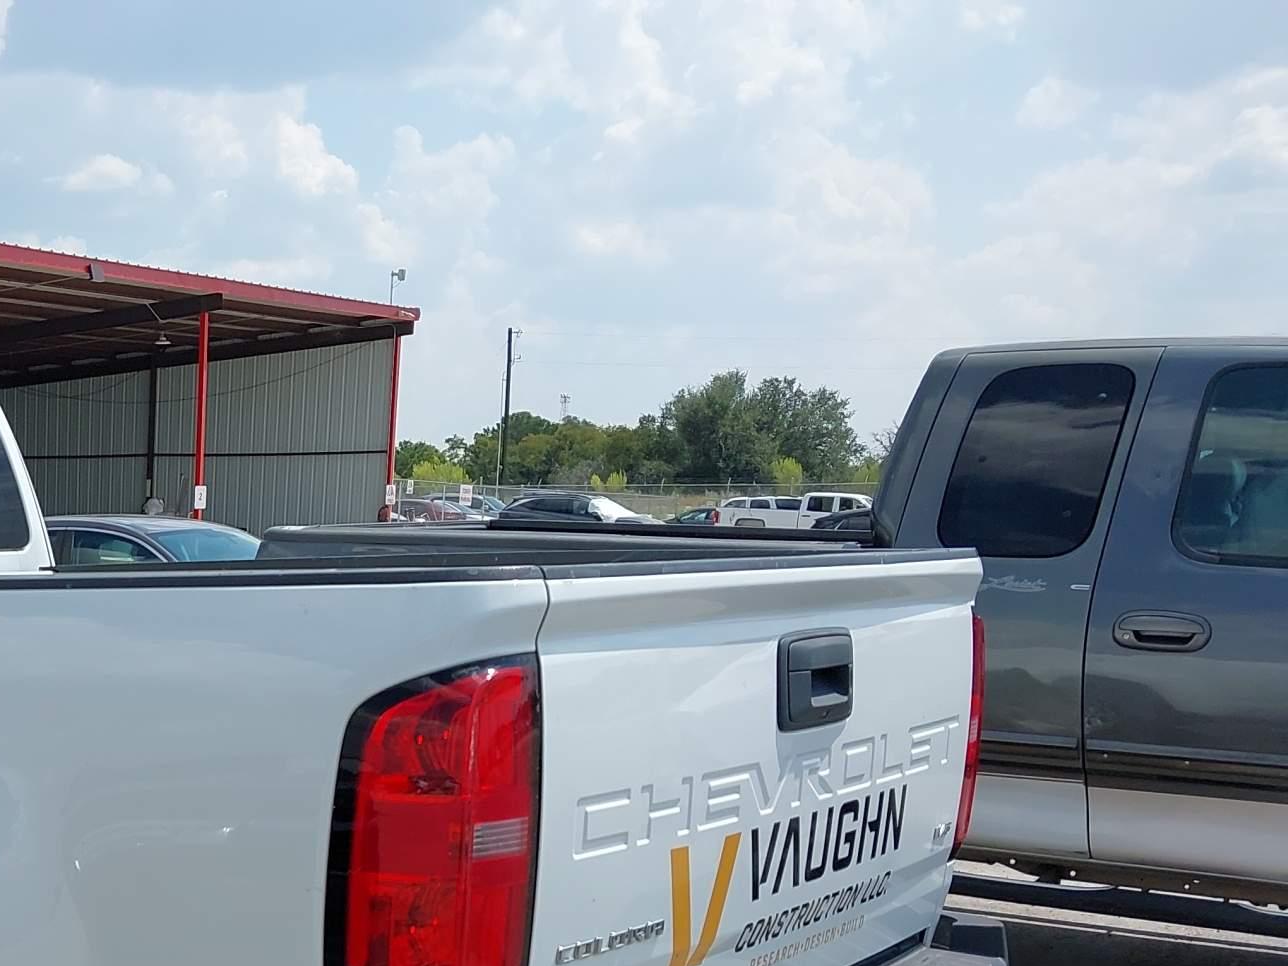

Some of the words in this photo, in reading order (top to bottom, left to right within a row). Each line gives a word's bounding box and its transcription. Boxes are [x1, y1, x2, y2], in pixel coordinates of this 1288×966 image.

[572, 714, 959, 860] CHEVROLET
[750, 784, 908, 901] VAUGHN
[734, 882, 861, 953] CONSTRUCTION
[860, 871, 891, 903] LLC.
